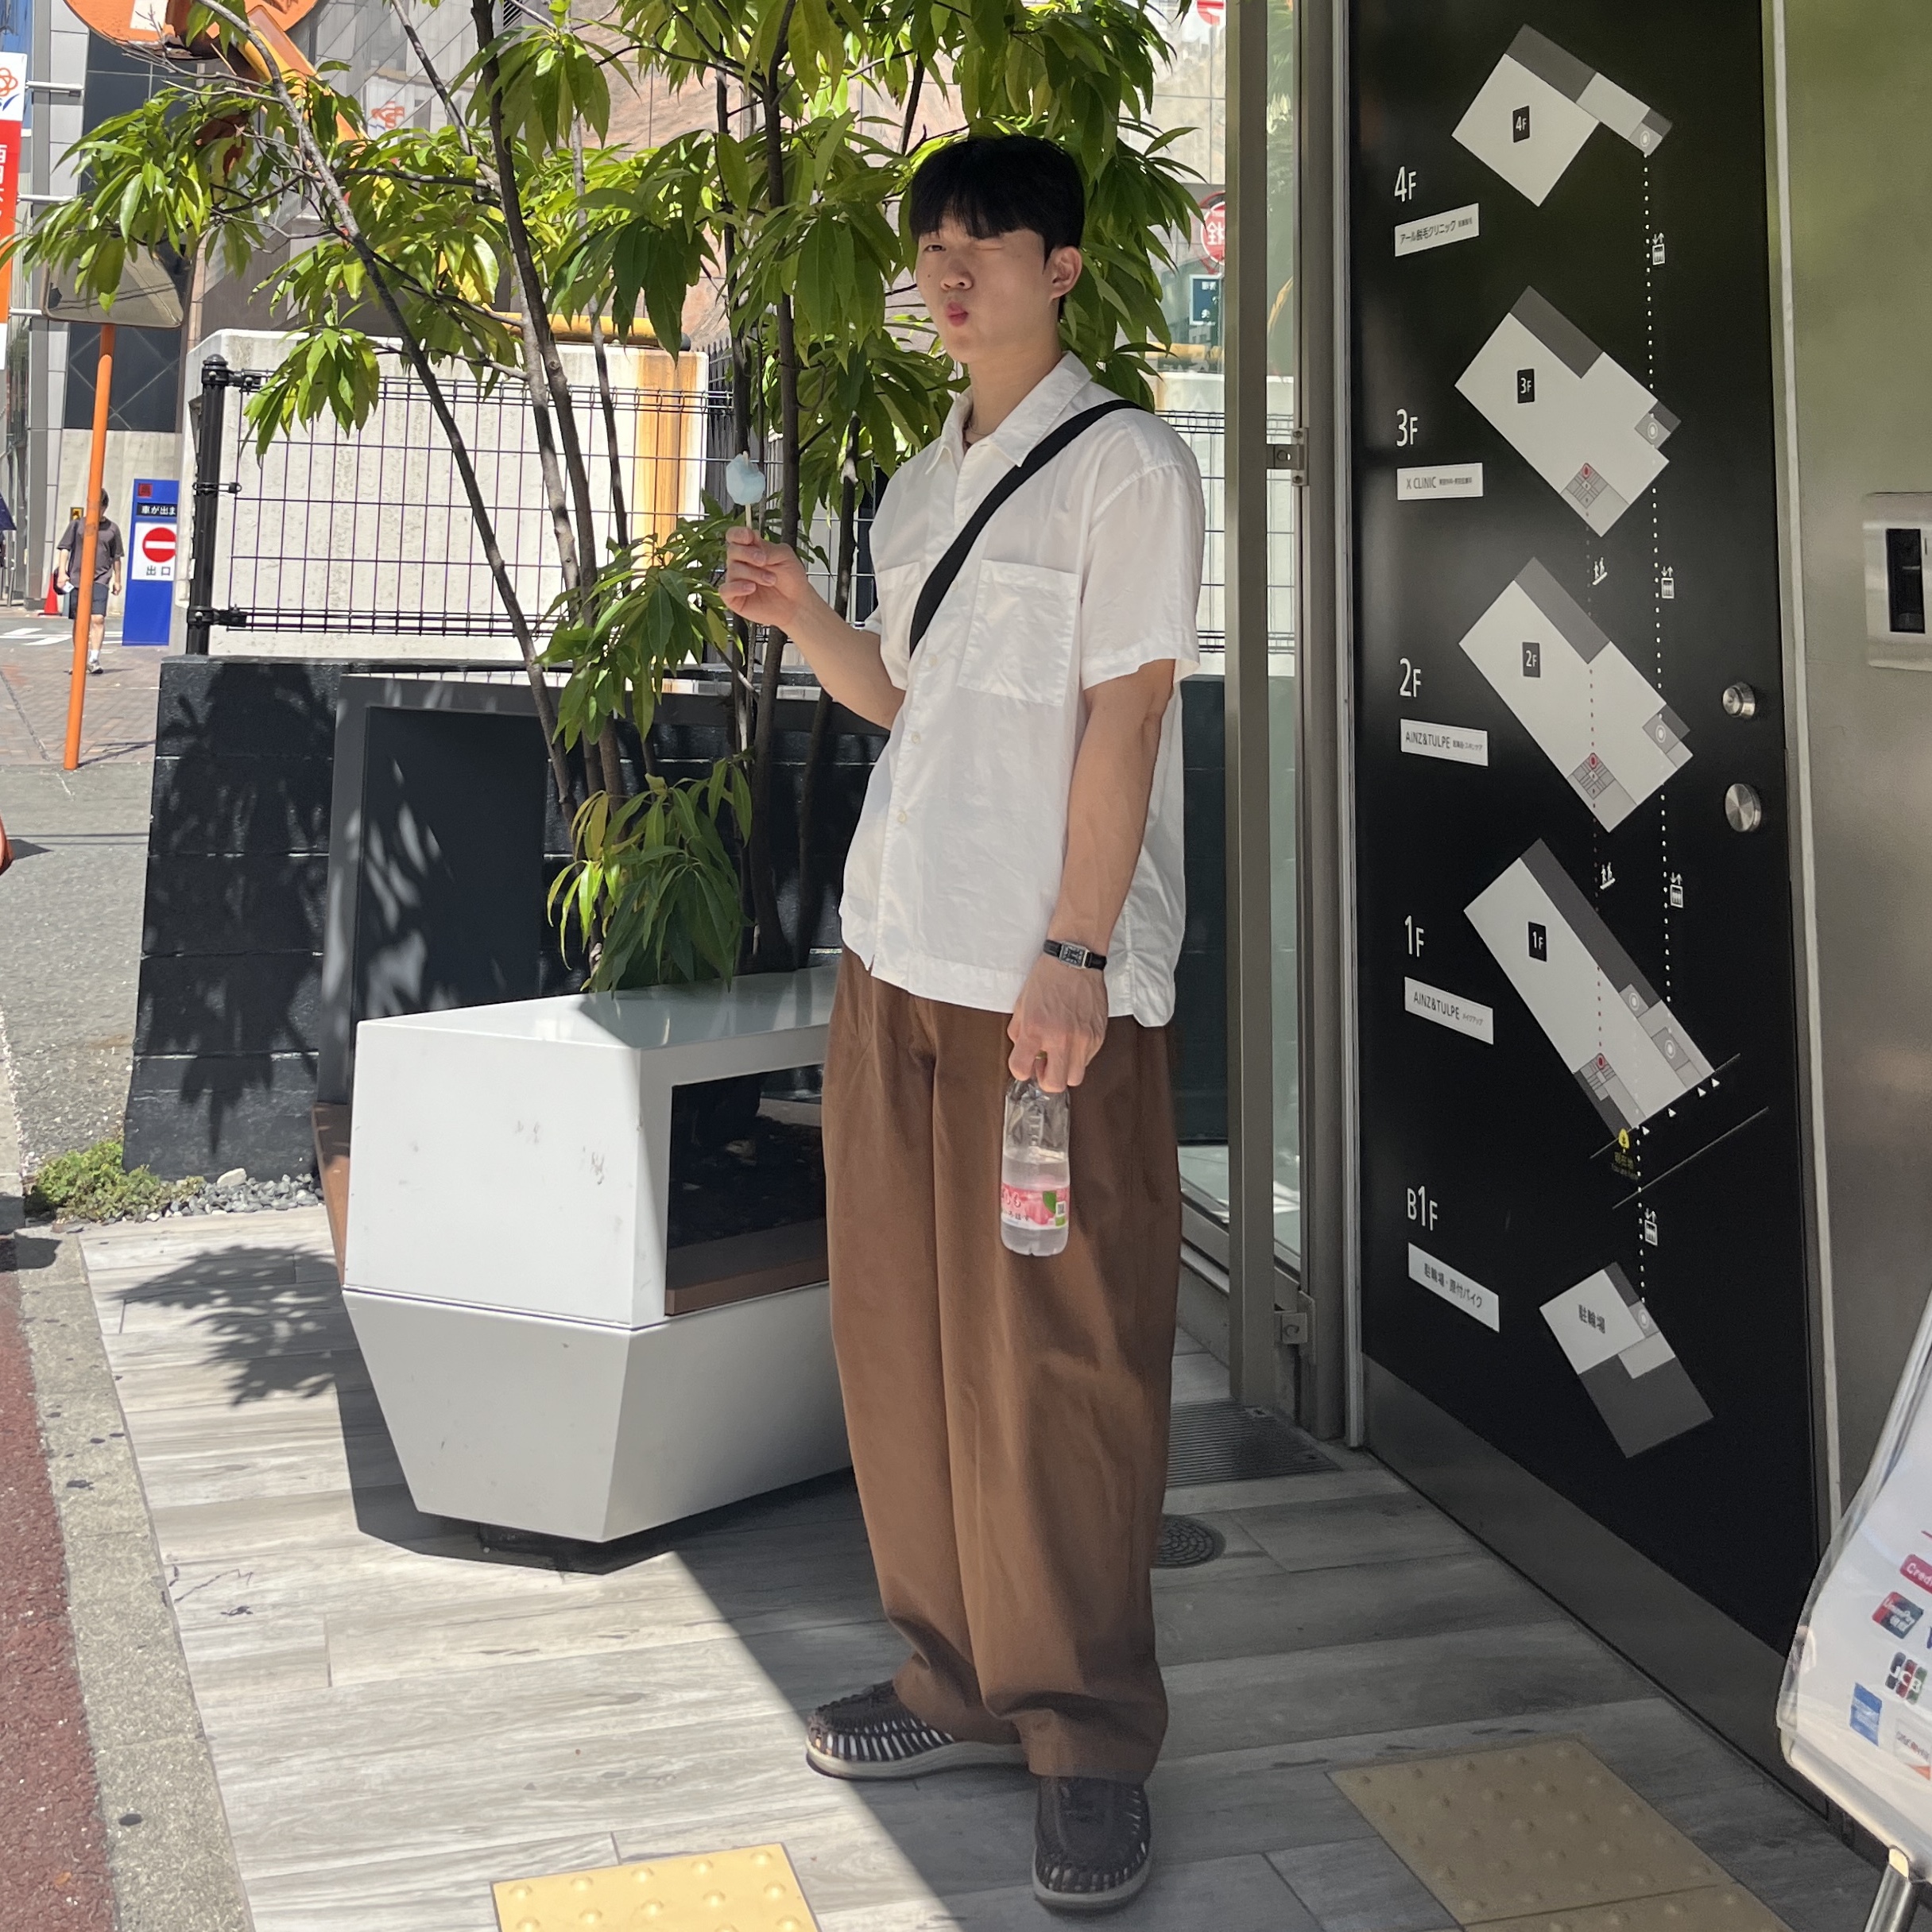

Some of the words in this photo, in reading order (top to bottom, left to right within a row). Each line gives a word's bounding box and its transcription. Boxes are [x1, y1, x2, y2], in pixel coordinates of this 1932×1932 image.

[1516, 116, 1527, 131] 4F
[1394, 166, 1417, 202] 4F
[1520, 377, 1532, 394] 3F
[1396, 408, 1419, 447] 3F
[1413, 476, 1437, 490] CLINIC
[145, 565, 171, 576] 出口
[1525, 649, 1538, 668] 2F
[1400, 657, 1422, 698] 2F
[1405, 731, 1450, 749] AINZ&TULPE
[1404, 915, 1425, 958] 1F
[1532, 931, 1544, 950] 1F
[1413, 992, 1460, 1020] AINZ&TULPE
[1407, 1185, 1438, 1231] B1F
[1889, 1665, 1922, 1694] JCB
